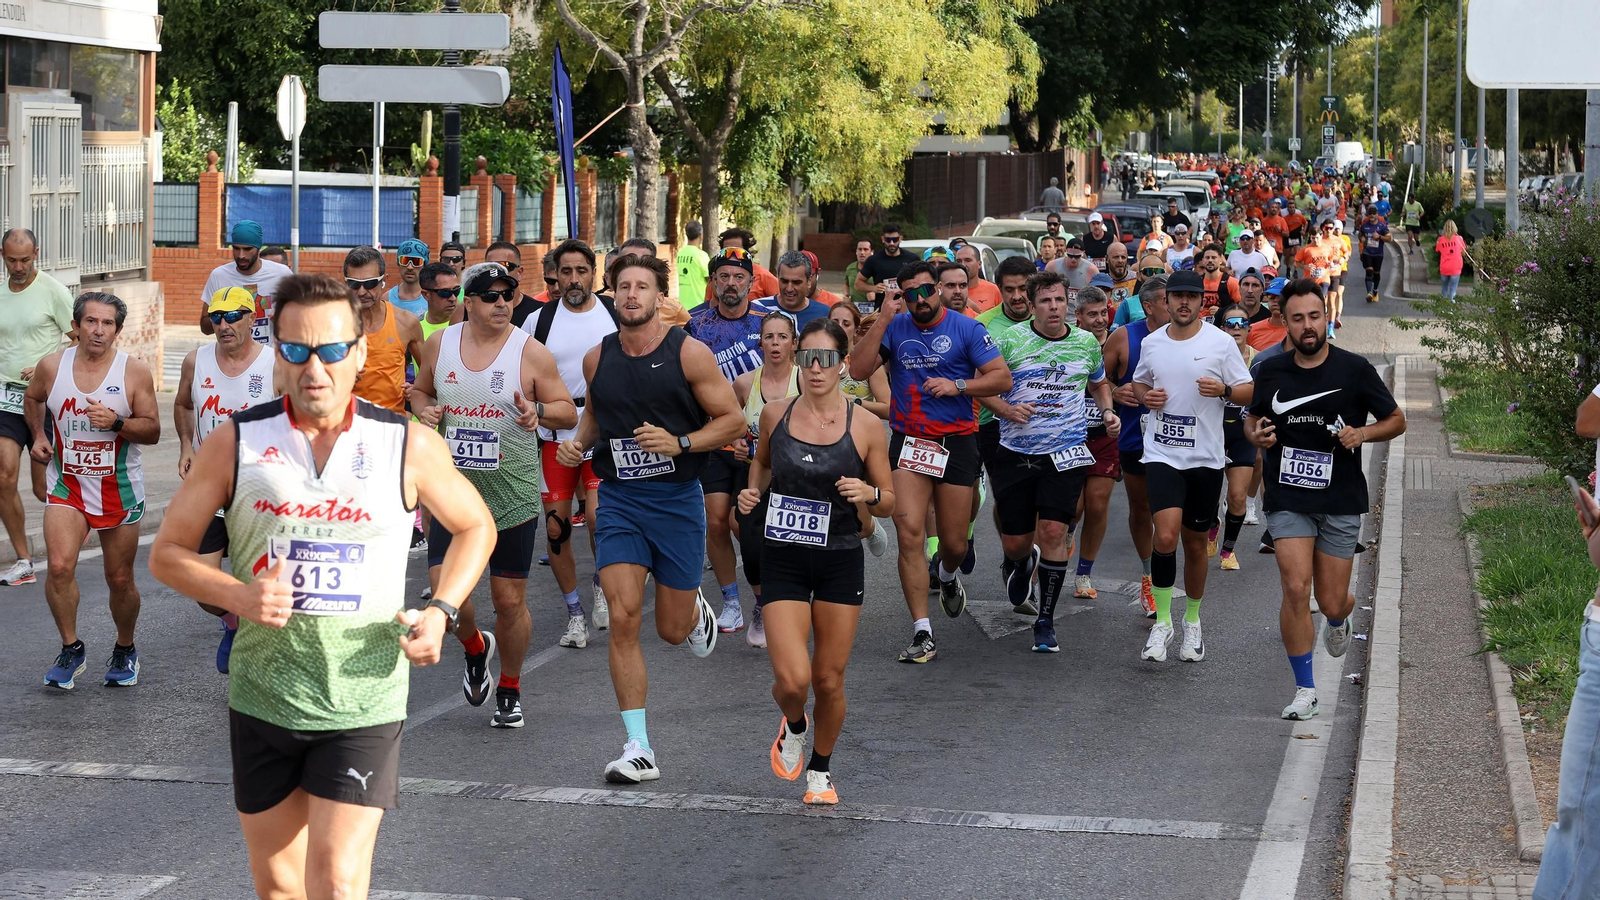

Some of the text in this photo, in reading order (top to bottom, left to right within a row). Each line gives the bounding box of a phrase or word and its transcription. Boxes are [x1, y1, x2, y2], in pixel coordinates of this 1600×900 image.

[443, 403, 505, 419] maratón
[1287, 414, 1324, 426] Running
[1162, 424, 1185, 437] 855
[457, 442, 483, 457] 611
[912, 449, 935, 464] 561
[75, 452, 101, 465] 145
[1289, 461, 1323, 477] 1056
[253, 497, 372, 523] maratón
[776, 511, 819, 530] 1018
[280, 525, 334, 537] JEREZ
[291, 564, 341, 590] 613
